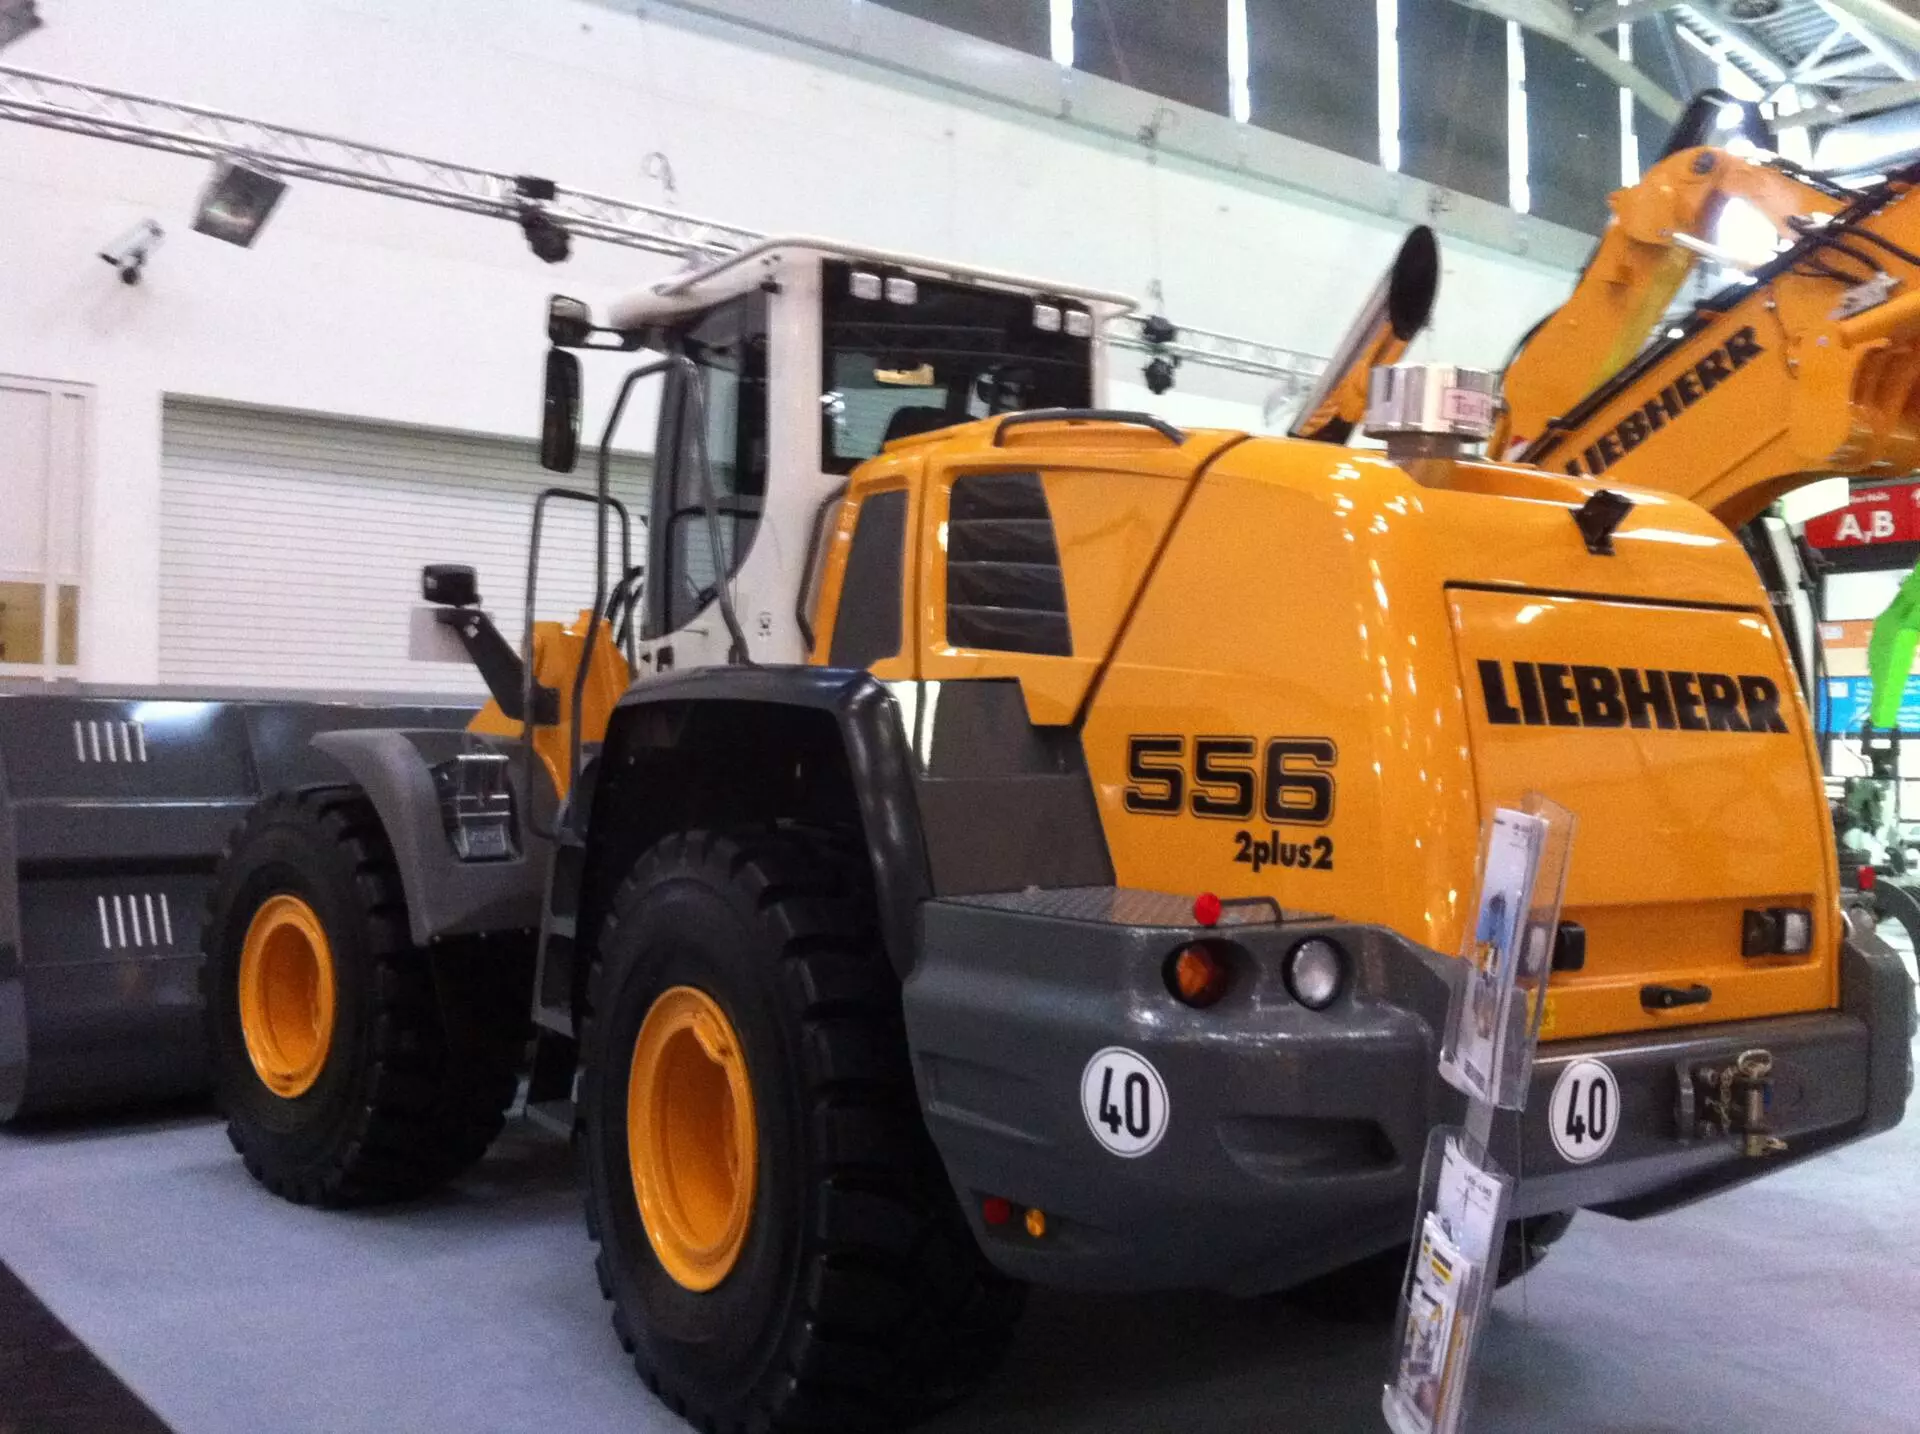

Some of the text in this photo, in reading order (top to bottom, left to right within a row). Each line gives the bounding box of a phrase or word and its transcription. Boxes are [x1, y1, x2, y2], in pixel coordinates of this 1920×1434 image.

[1835, 510, 1896, 544] A,B
[1477, 659, 1790, 734] LIEBHERR
[1123, 734, 1338, 828] 556
[1234, 830, 1334, 873] 2plus2
[1099, 1066, 1150, 1138] 40
[1566, 1078, 1607, 1144] 40
